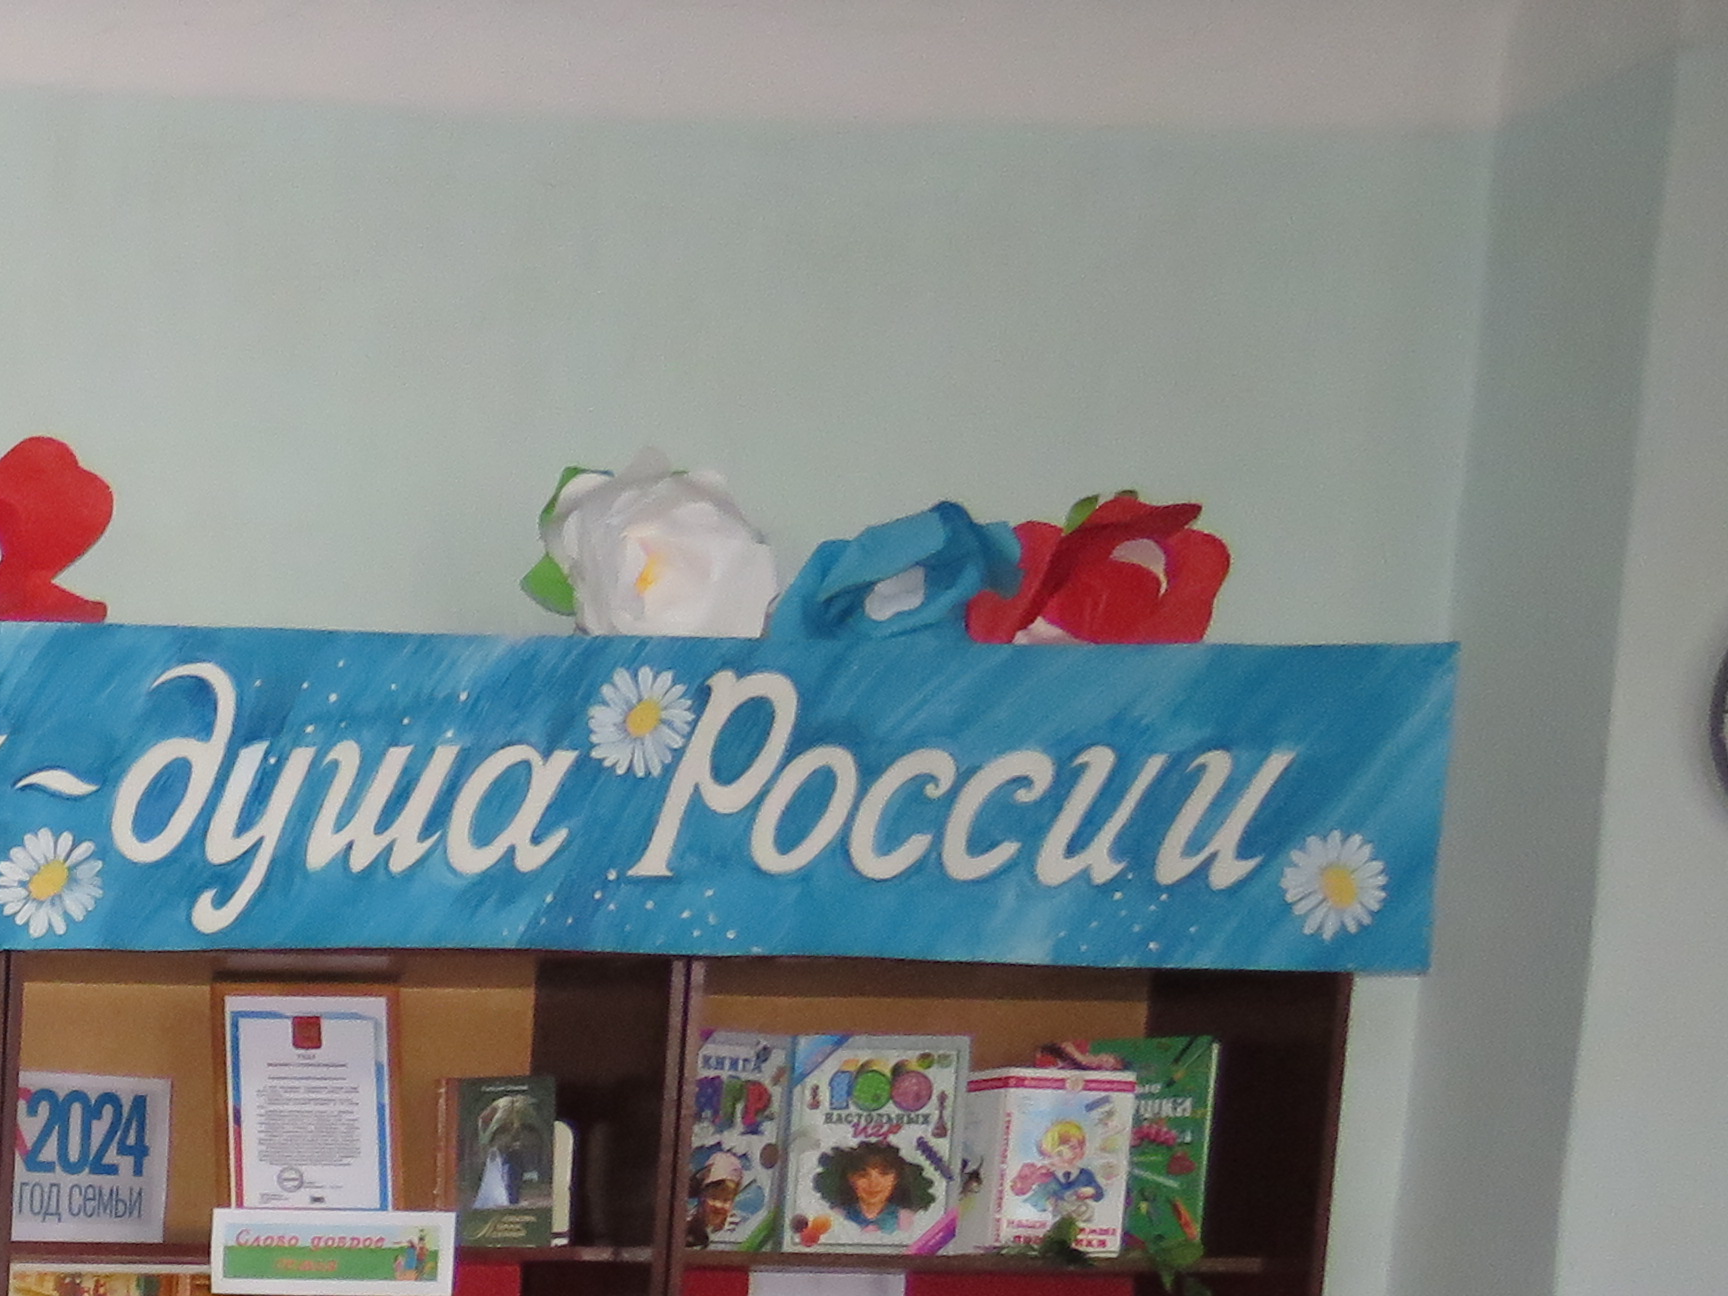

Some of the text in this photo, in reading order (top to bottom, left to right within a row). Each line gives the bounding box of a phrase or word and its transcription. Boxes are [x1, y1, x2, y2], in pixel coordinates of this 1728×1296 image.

[628, 668, 1294, 888] России
[25, 1087, 151, 1178] 2024
[823, 1112, 932, 1125] НАСТОЛЬНЫХ
[18, 1182, 63, 1224] ГОД
